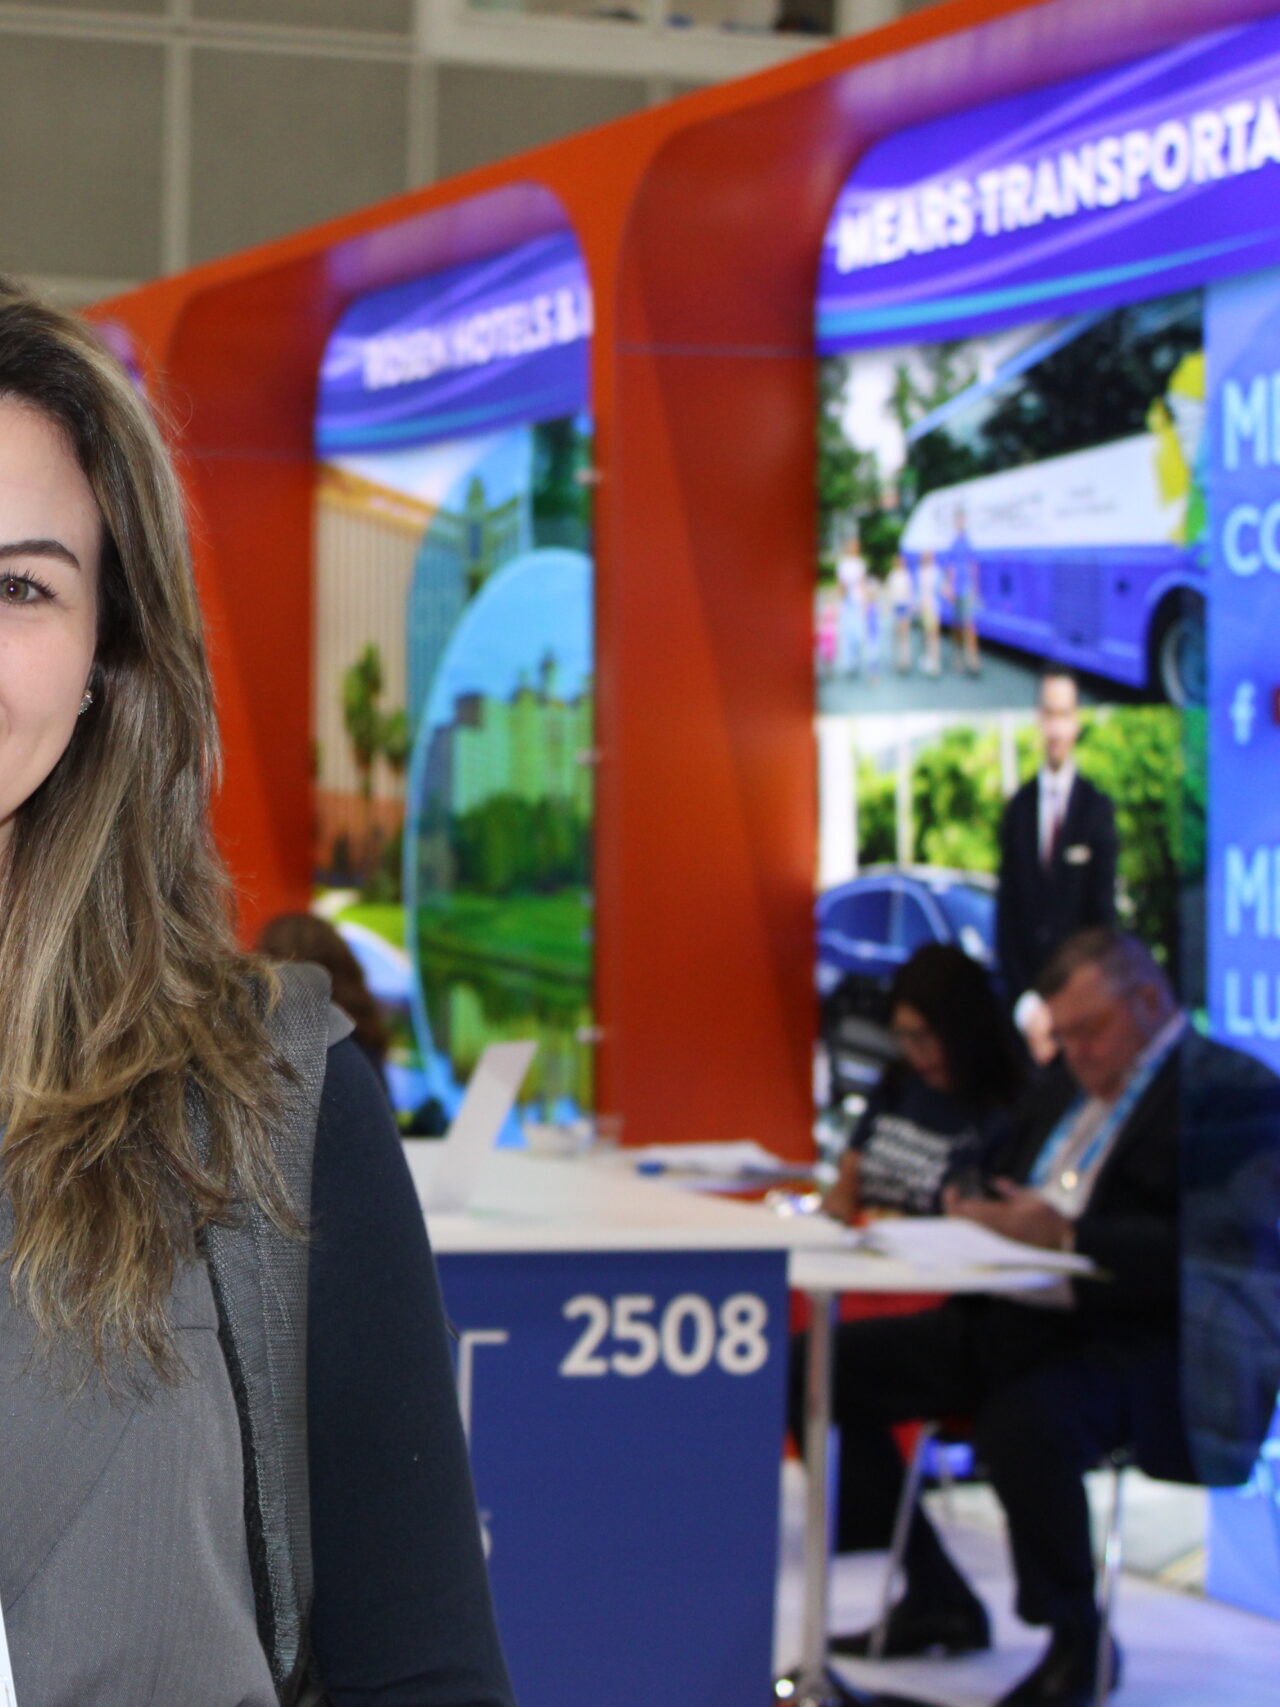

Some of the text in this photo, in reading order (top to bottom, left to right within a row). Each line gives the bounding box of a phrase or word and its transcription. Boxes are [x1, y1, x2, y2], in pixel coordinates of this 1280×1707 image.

[836, 178, 974, 273] MEARS
[451, 294, 551, 370] HOTELS
[558, 1292, 770, 1377] 2508
